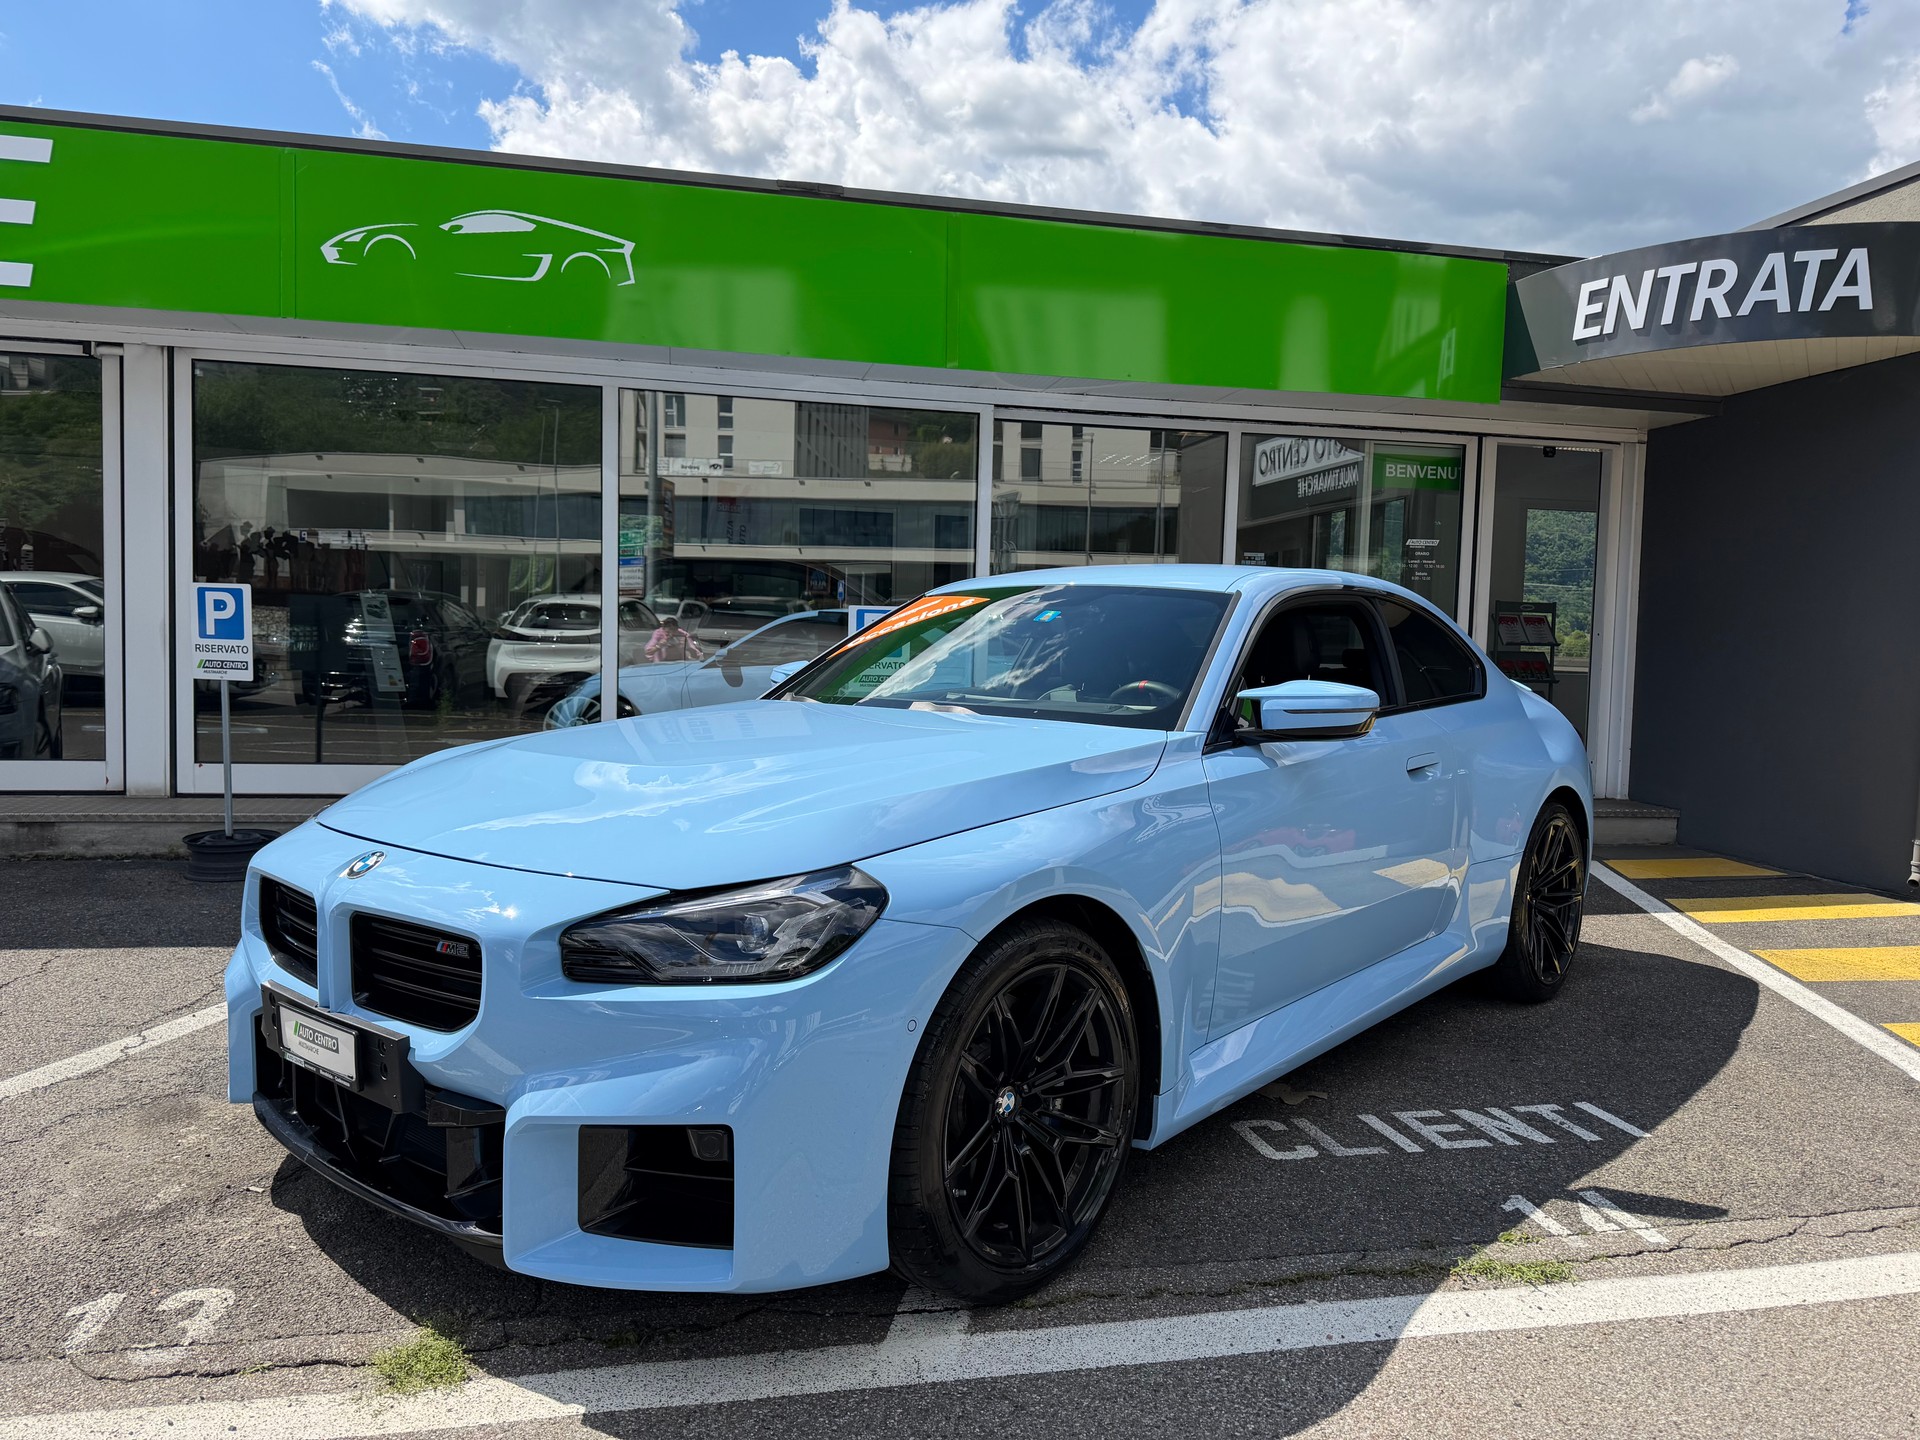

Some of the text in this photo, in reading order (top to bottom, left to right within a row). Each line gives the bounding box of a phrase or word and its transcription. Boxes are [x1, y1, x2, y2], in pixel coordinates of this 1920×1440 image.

[1572, 247, 1873, 341] ENTRATA
[1385, 463, 1461, 480] BENVENU
[205, 591, 236, 636] P
[194, 643, 249, 655] RISERVATO
[204, 660, 247, 669] AUTO CENTRO
[299, 1025, 337, 1050] AUTO CENTRO
[1231, 1101, 1651, 1160] CLIENTI
[1501, 1190, 1669, 1246] 14
